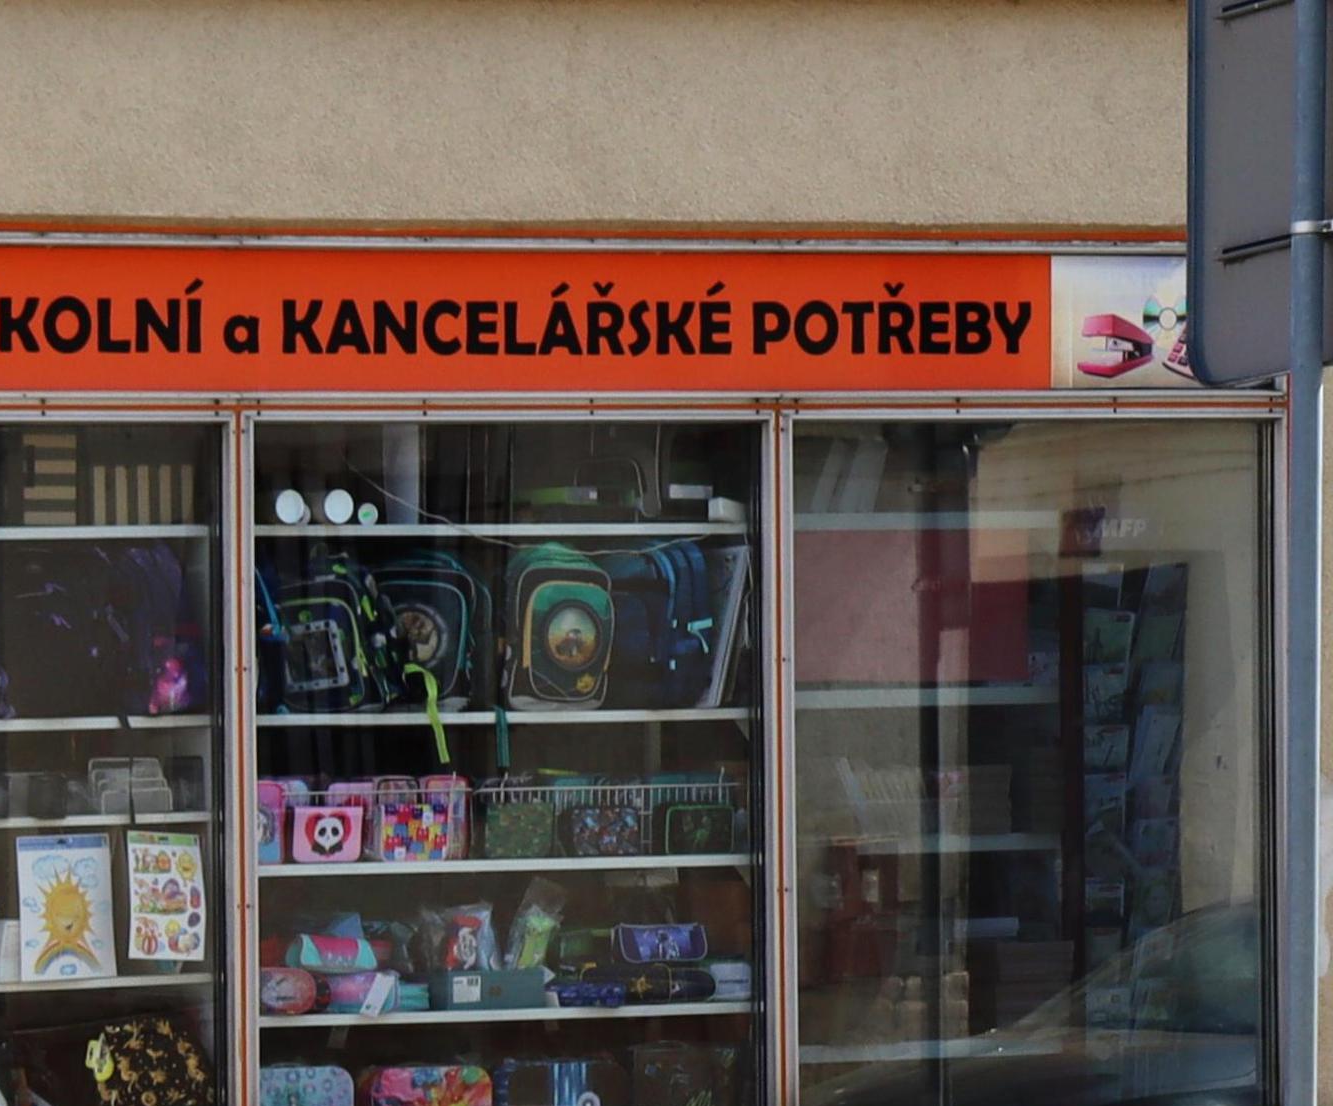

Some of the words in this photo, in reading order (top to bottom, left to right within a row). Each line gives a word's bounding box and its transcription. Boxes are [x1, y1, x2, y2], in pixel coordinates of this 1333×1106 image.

[223, 314, 260, 355] a
[281, 281, 733, 356] KANCELÁŘSKÉ
[752, 281, 1032, 356] POTŘEBY
